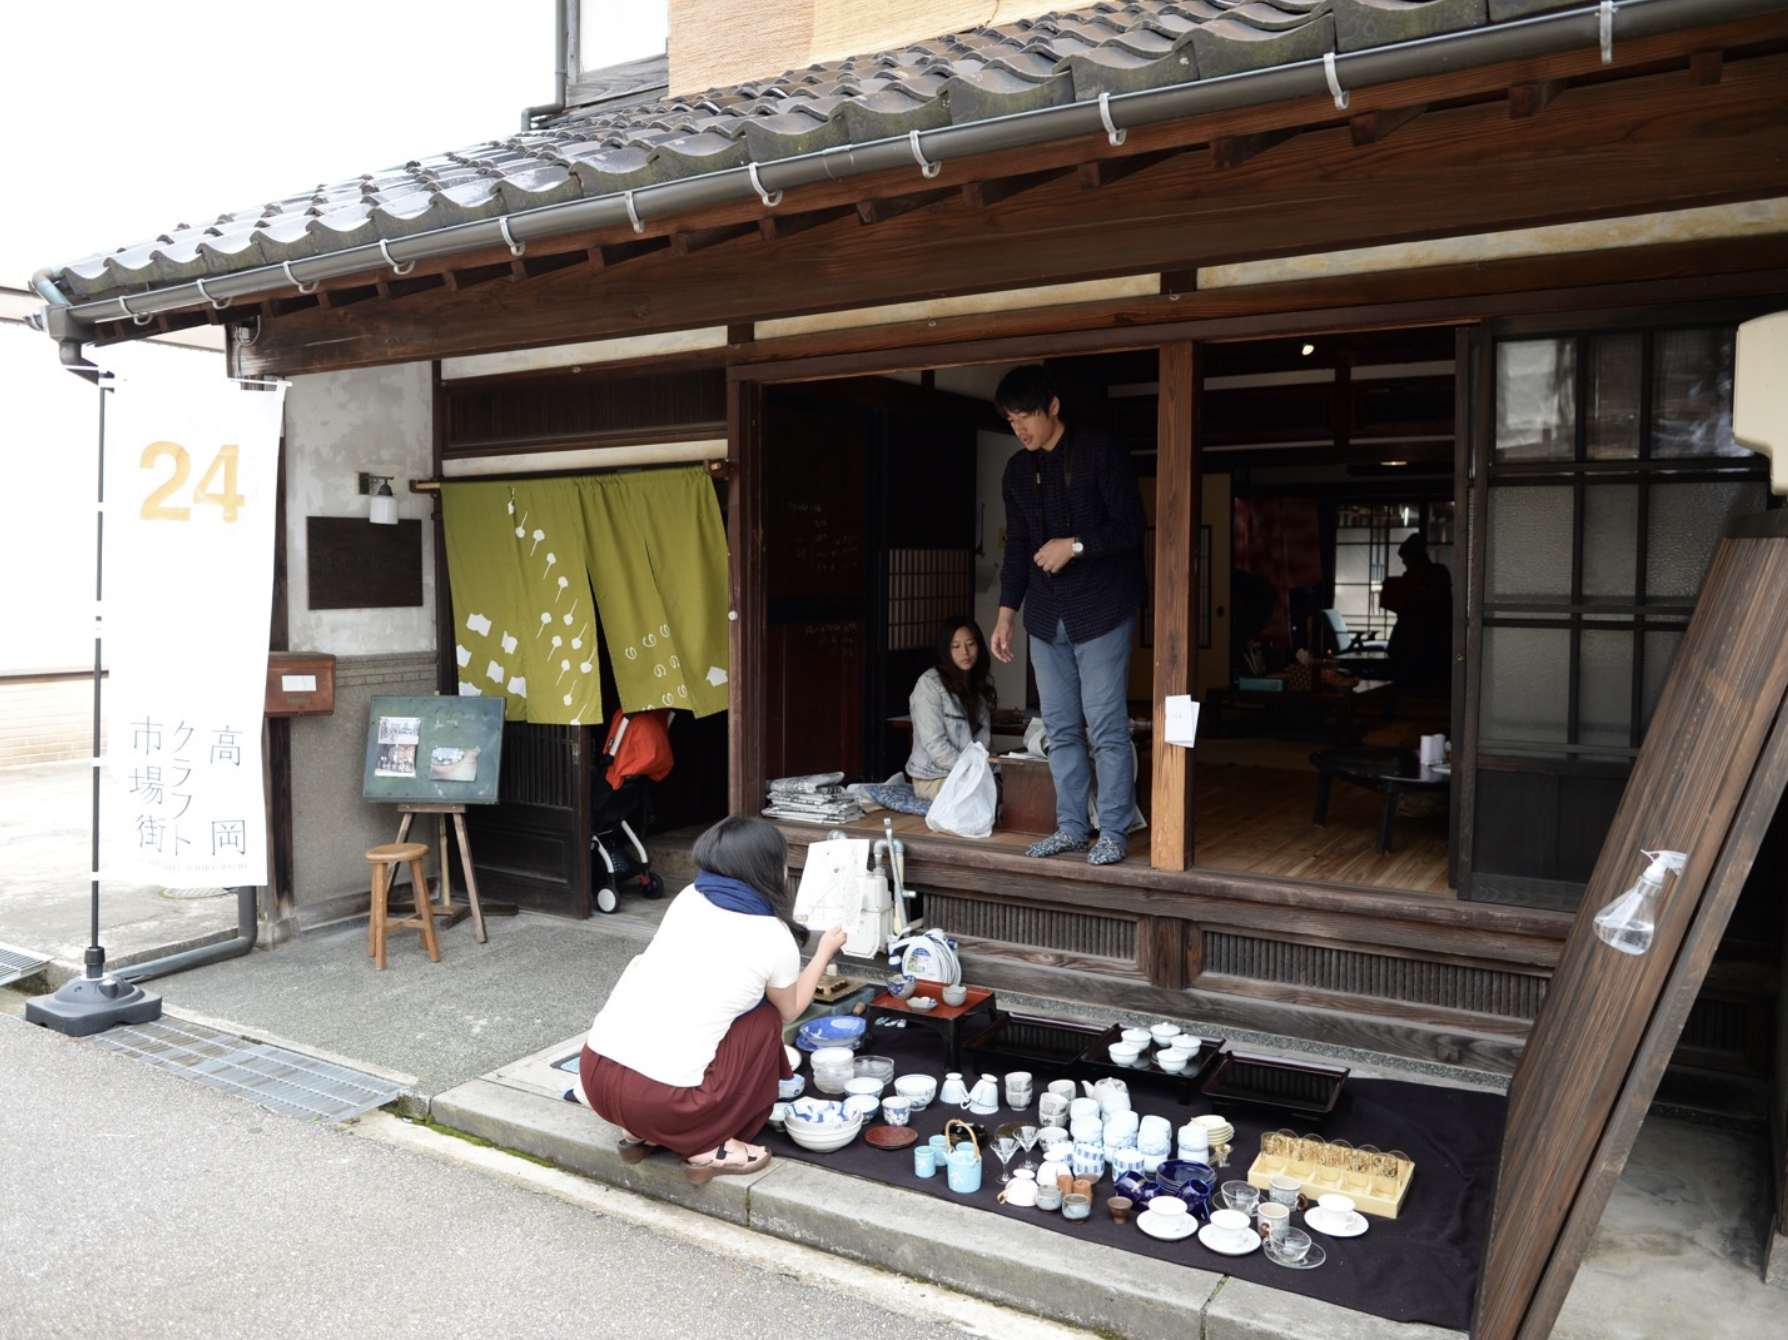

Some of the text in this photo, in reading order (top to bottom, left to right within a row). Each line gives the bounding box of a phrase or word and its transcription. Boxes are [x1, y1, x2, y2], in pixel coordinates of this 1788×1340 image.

[139, 440, 246, 523] 24
[128, 715, 167, 854] 市場街
[171, 719, 194, 857] クラフト
[210, 725, 246, 857] 高岡
